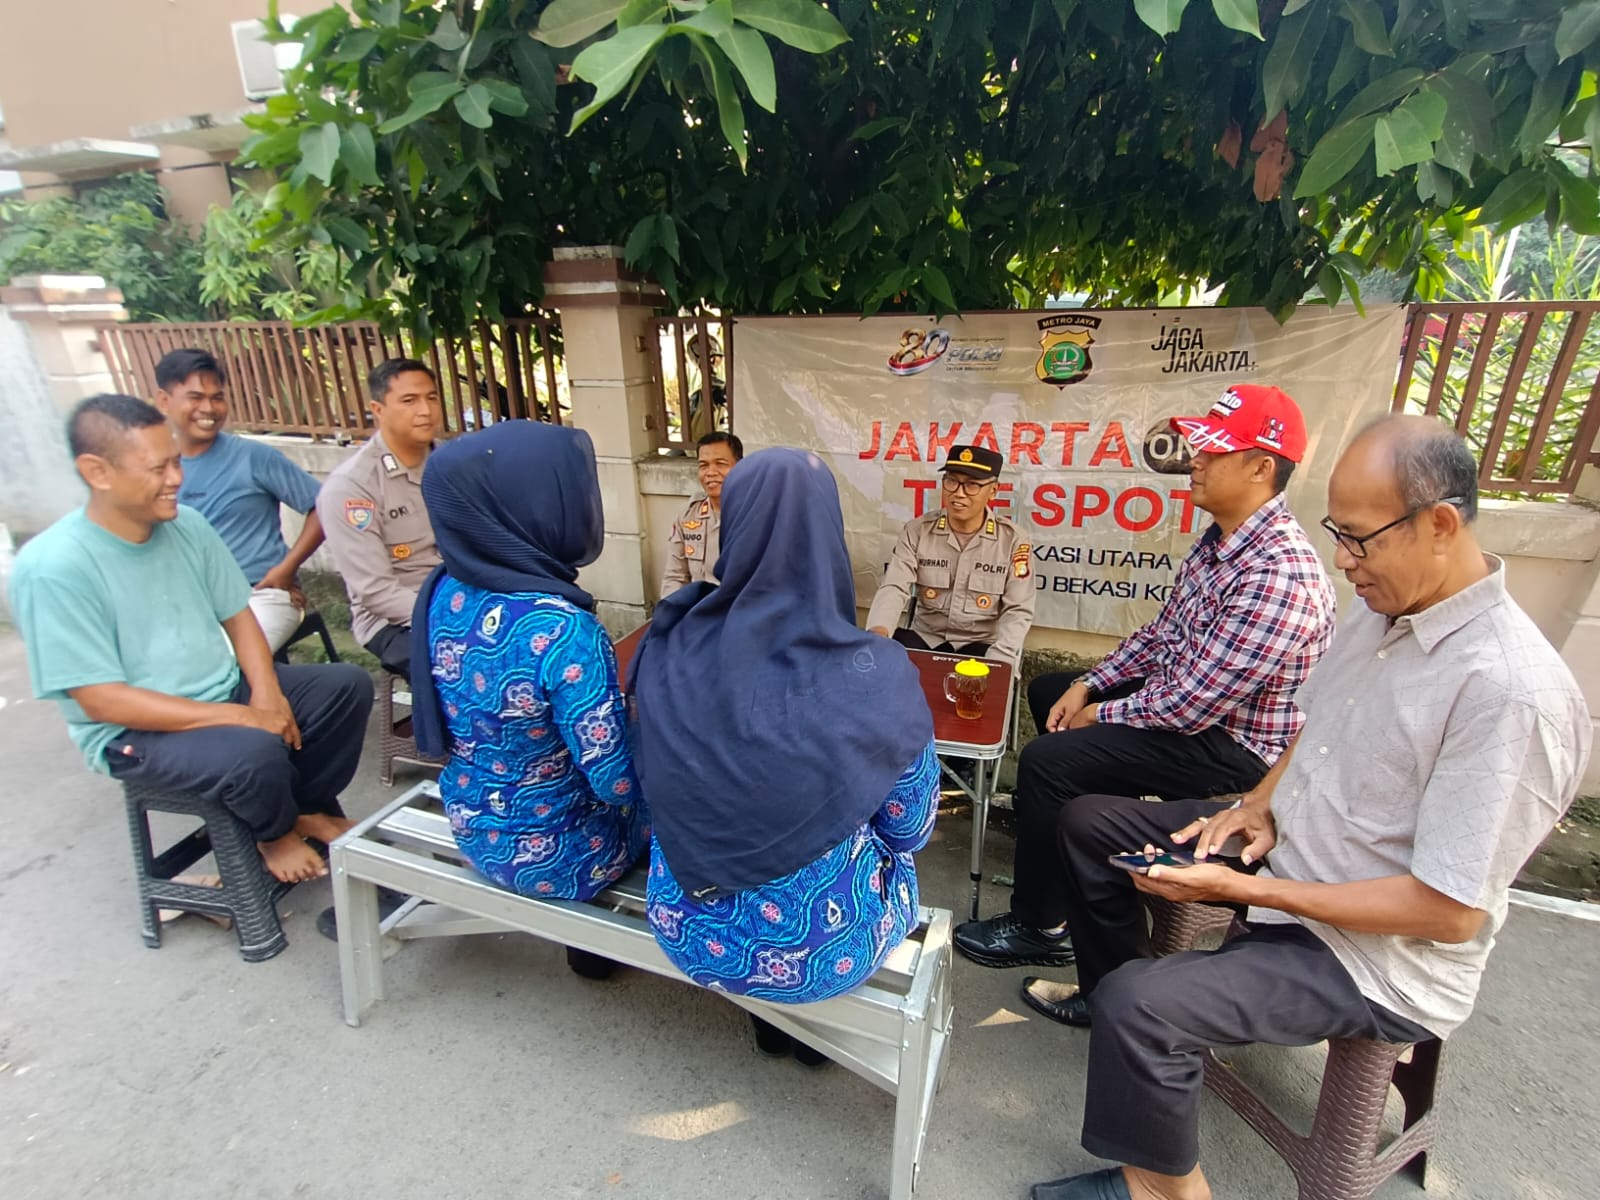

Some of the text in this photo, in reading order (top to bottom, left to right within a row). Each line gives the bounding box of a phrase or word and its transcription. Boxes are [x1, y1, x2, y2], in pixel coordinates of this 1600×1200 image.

[1042, 317, 1096, 328] METRO JAYA
[888, 328, 950, 376] 80
[1151, 325, 1204, 359] JAGA
[858, 420, 1134, 469] JAKARTA
[903, 478, 1195, 534] TE SPOT
[974, 562, 1007, 574] POLRI
[1032, 544, 1173, 571] KASI UTARA
[1053, 576, 1137, 599] BEKASI
